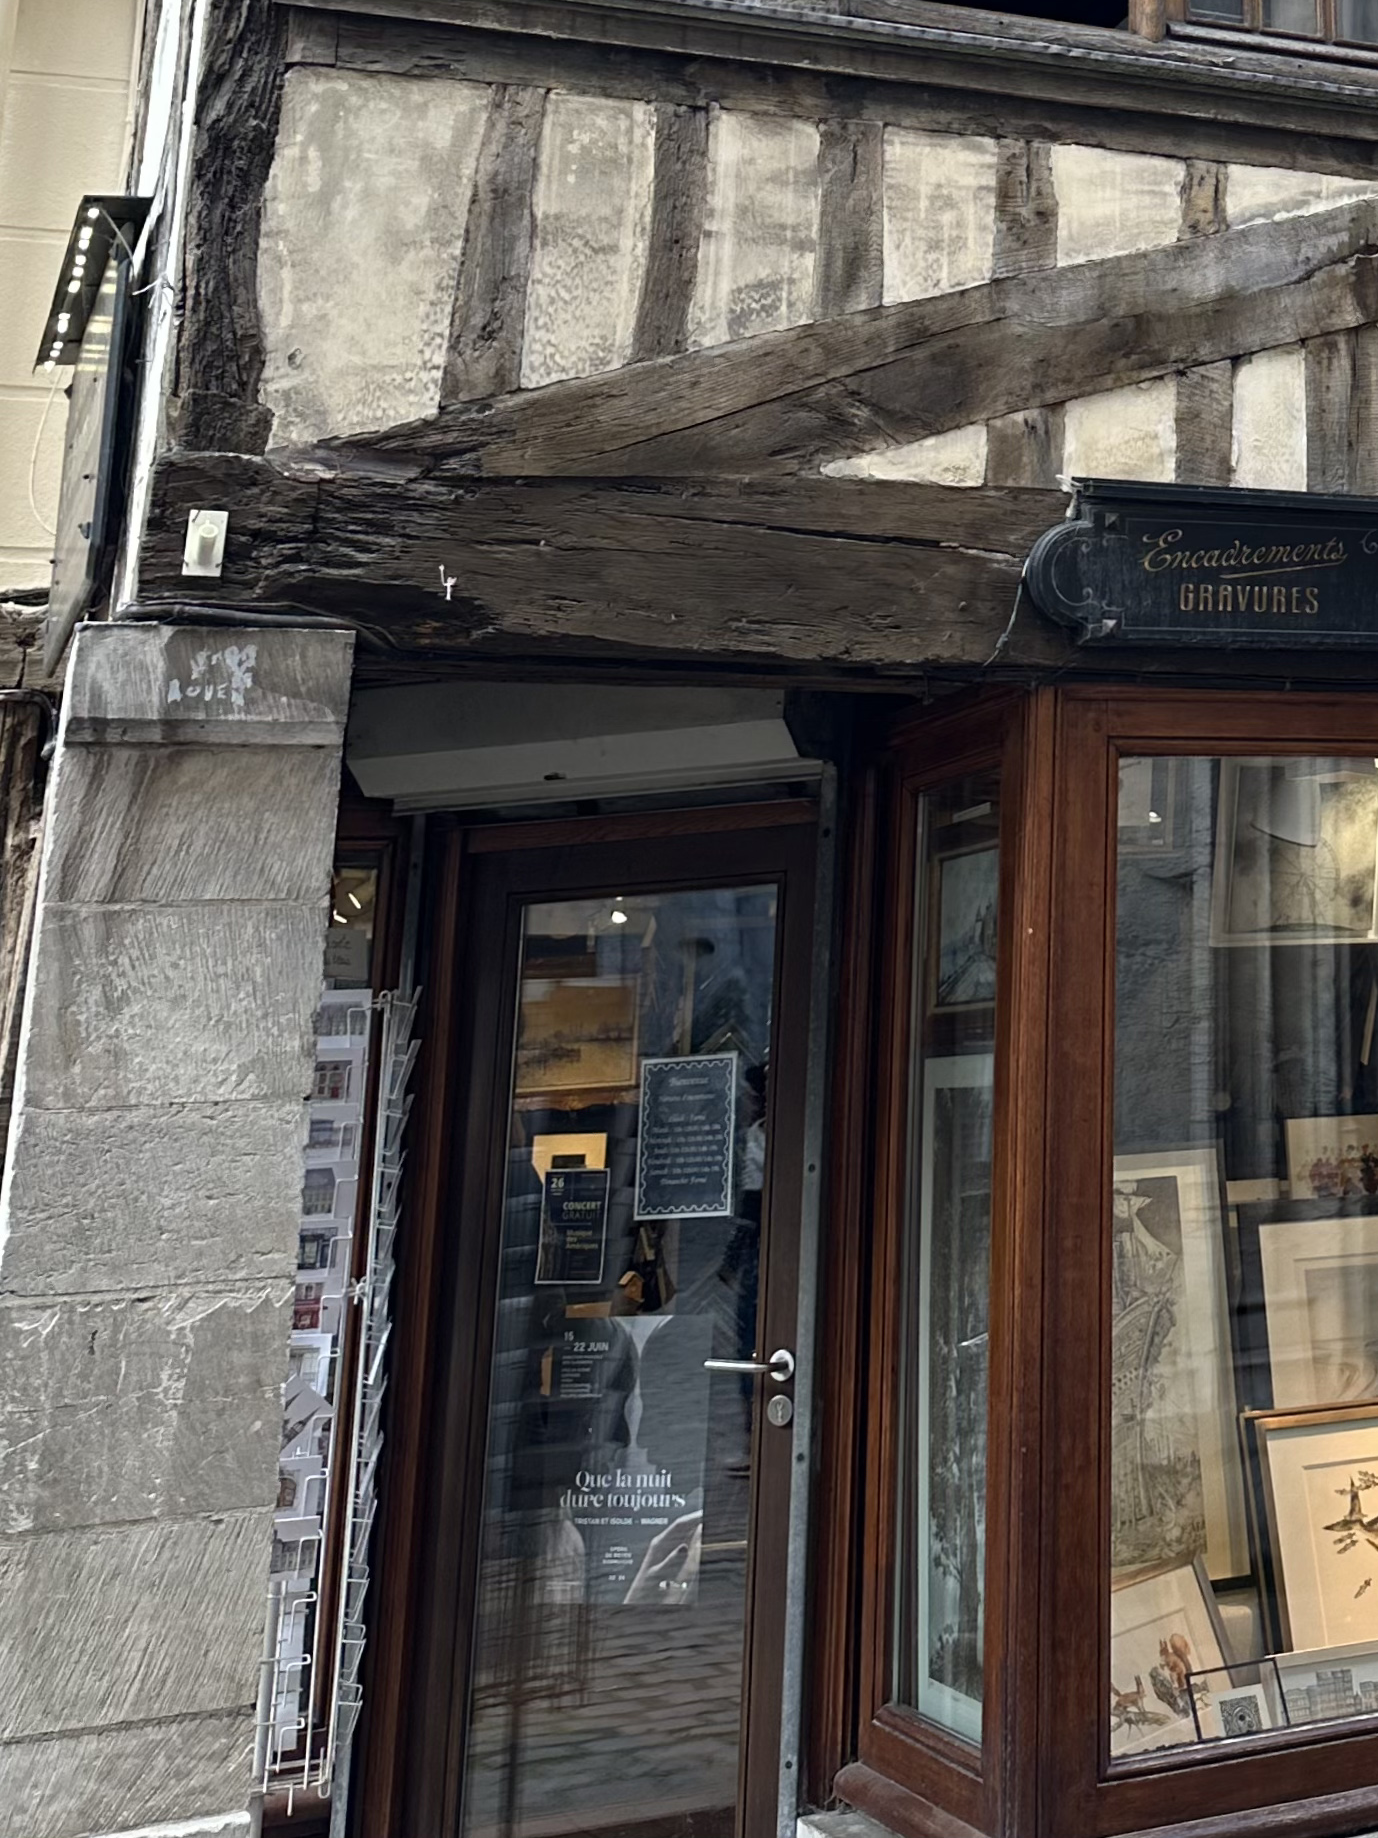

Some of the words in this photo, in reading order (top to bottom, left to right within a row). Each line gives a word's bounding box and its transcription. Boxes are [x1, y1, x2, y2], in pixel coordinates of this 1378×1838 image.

[1142, 528, 1348, 573] Encadrements
[1179, 582, 1320, 614] GRAVURES
[550, 1177, 565, 1189] 26
[562, 1201, 602, 1211] CONCERT
[562, 1210, 602, 1220] GRATUIT
[563, 1330, 575, 1342] 15
[573, 1341, 586, 1352] 22
[587, 1341, 609, 1352] JUIN
[575, 1470, 612, 1492] Que
[616, 1468, 632, 1488] la
[635, 1468, 672, 1488] nuit
[559, 1489, 604, 1508] dure
[607, 1488, 687, 1511] toujours
[574, 1517, 600, 1525] TRISTAN
[600, 1517, 609, 1525] ET
[609, 1517, 633, 1525] ISOLDE
[640, 1517, 669, 1525] WAGNER
